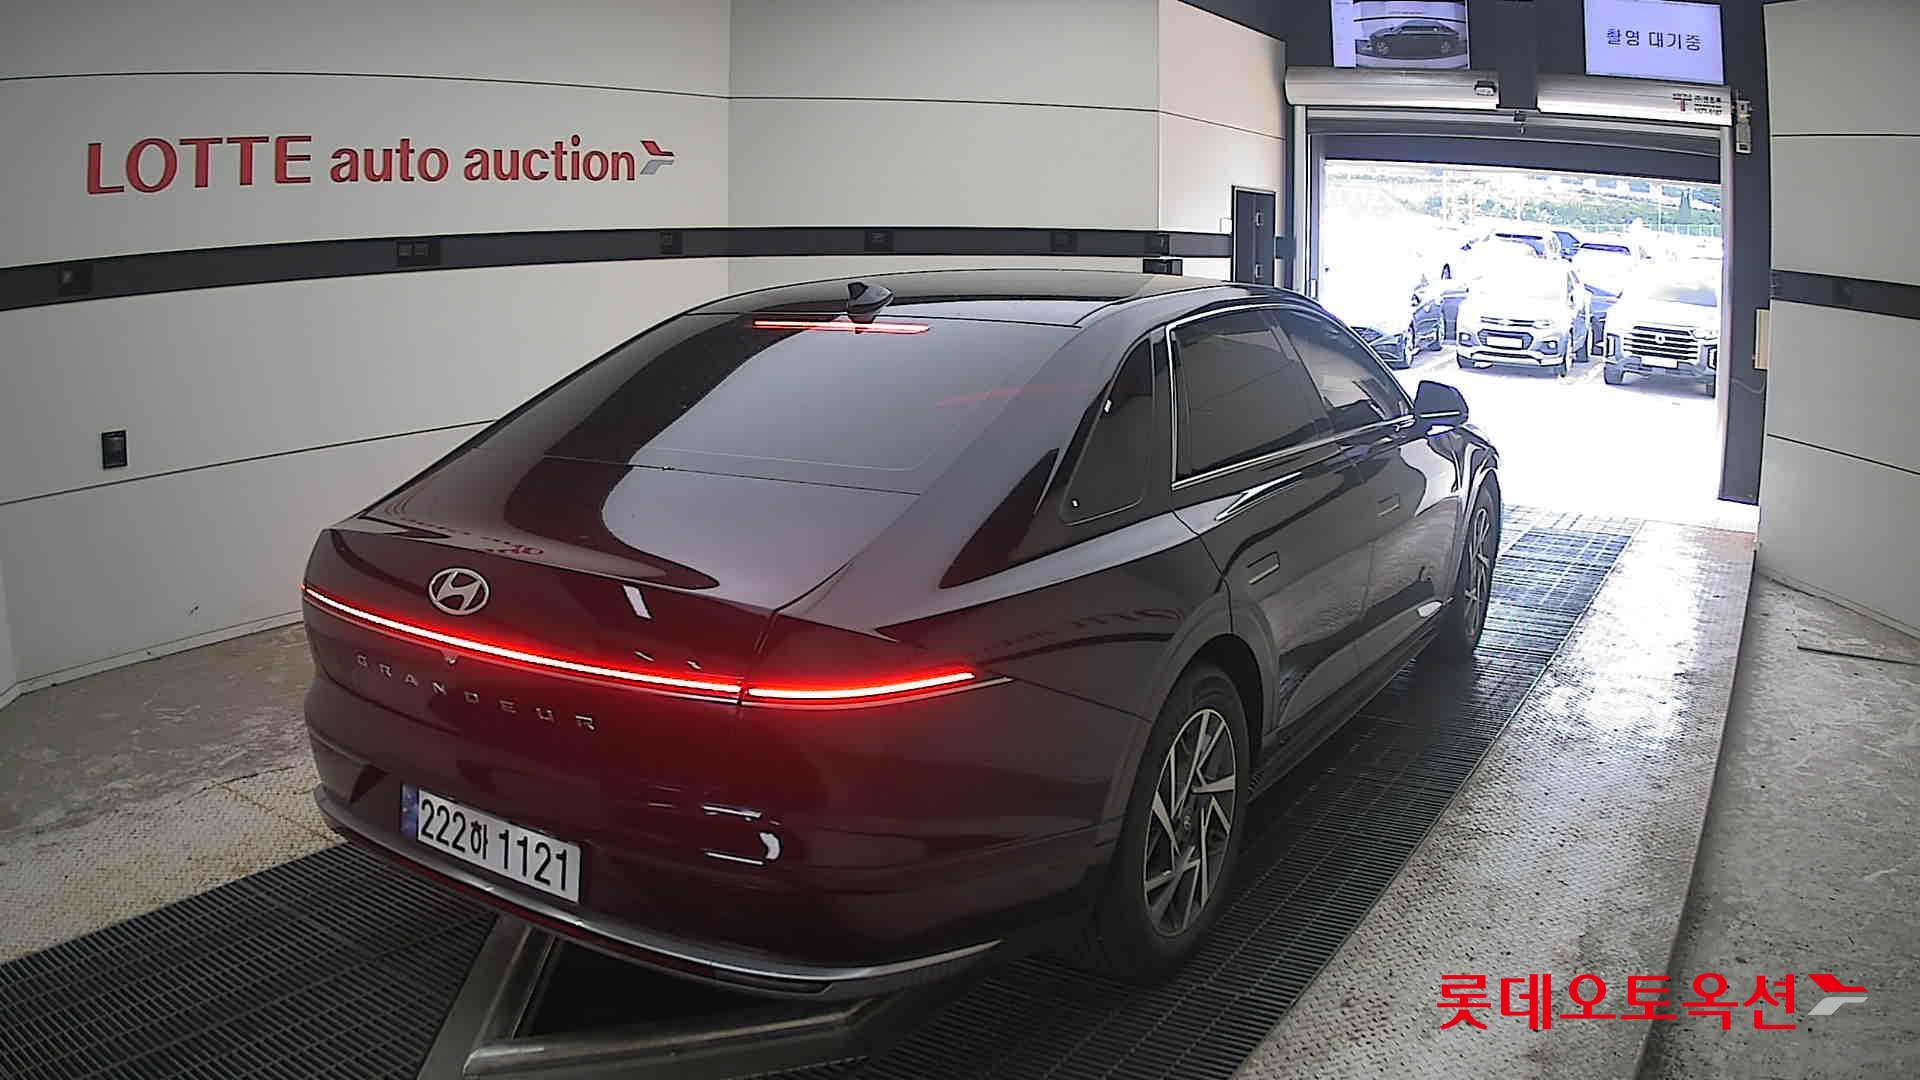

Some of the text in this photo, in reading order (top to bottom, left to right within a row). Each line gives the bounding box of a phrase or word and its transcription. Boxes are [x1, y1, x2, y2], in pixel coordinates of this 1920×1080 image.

[1606, 27, 1701, 52] 촬영 대기중
[87, 134, 636, 195] LOTTE auto auction
[356, 653, 597, 732] GRANDEUR
[420, 798, 568, 892] 222하 1121
